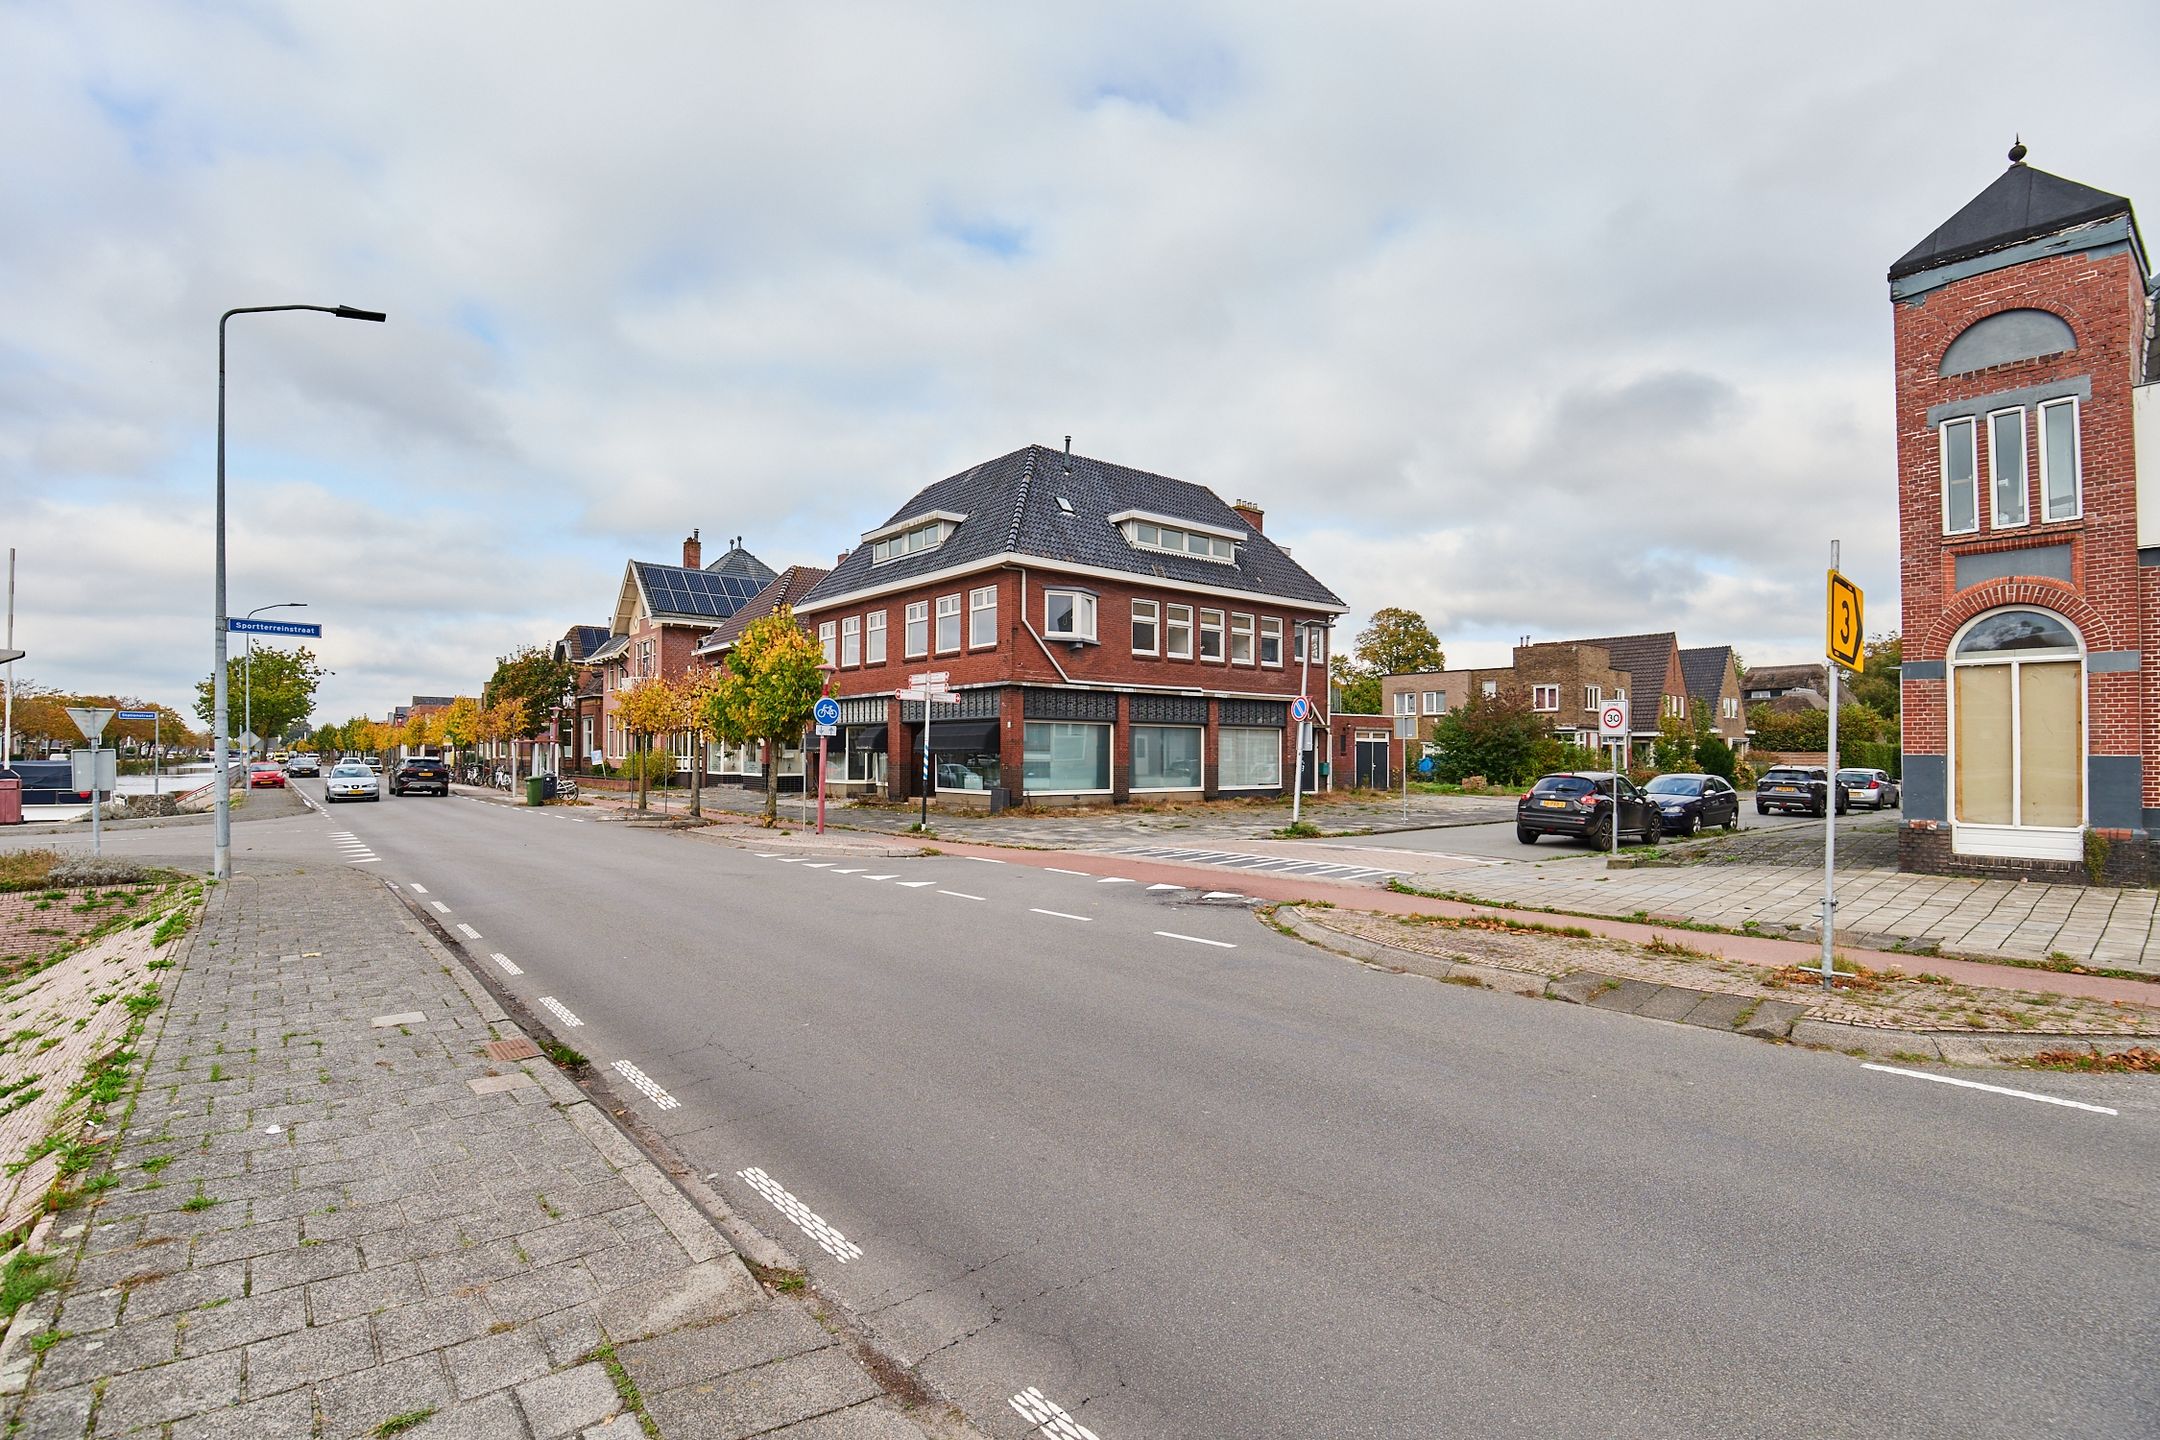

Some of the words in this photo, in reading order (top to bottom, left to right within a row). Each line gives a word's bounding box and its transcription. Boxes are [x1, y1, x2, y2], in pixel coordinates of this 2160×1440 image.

[235, 621, 315, 634] Sportterreinstraat
[1840, 600, 1850, 645] 3
[1607, 714, 1620, 723] 30
